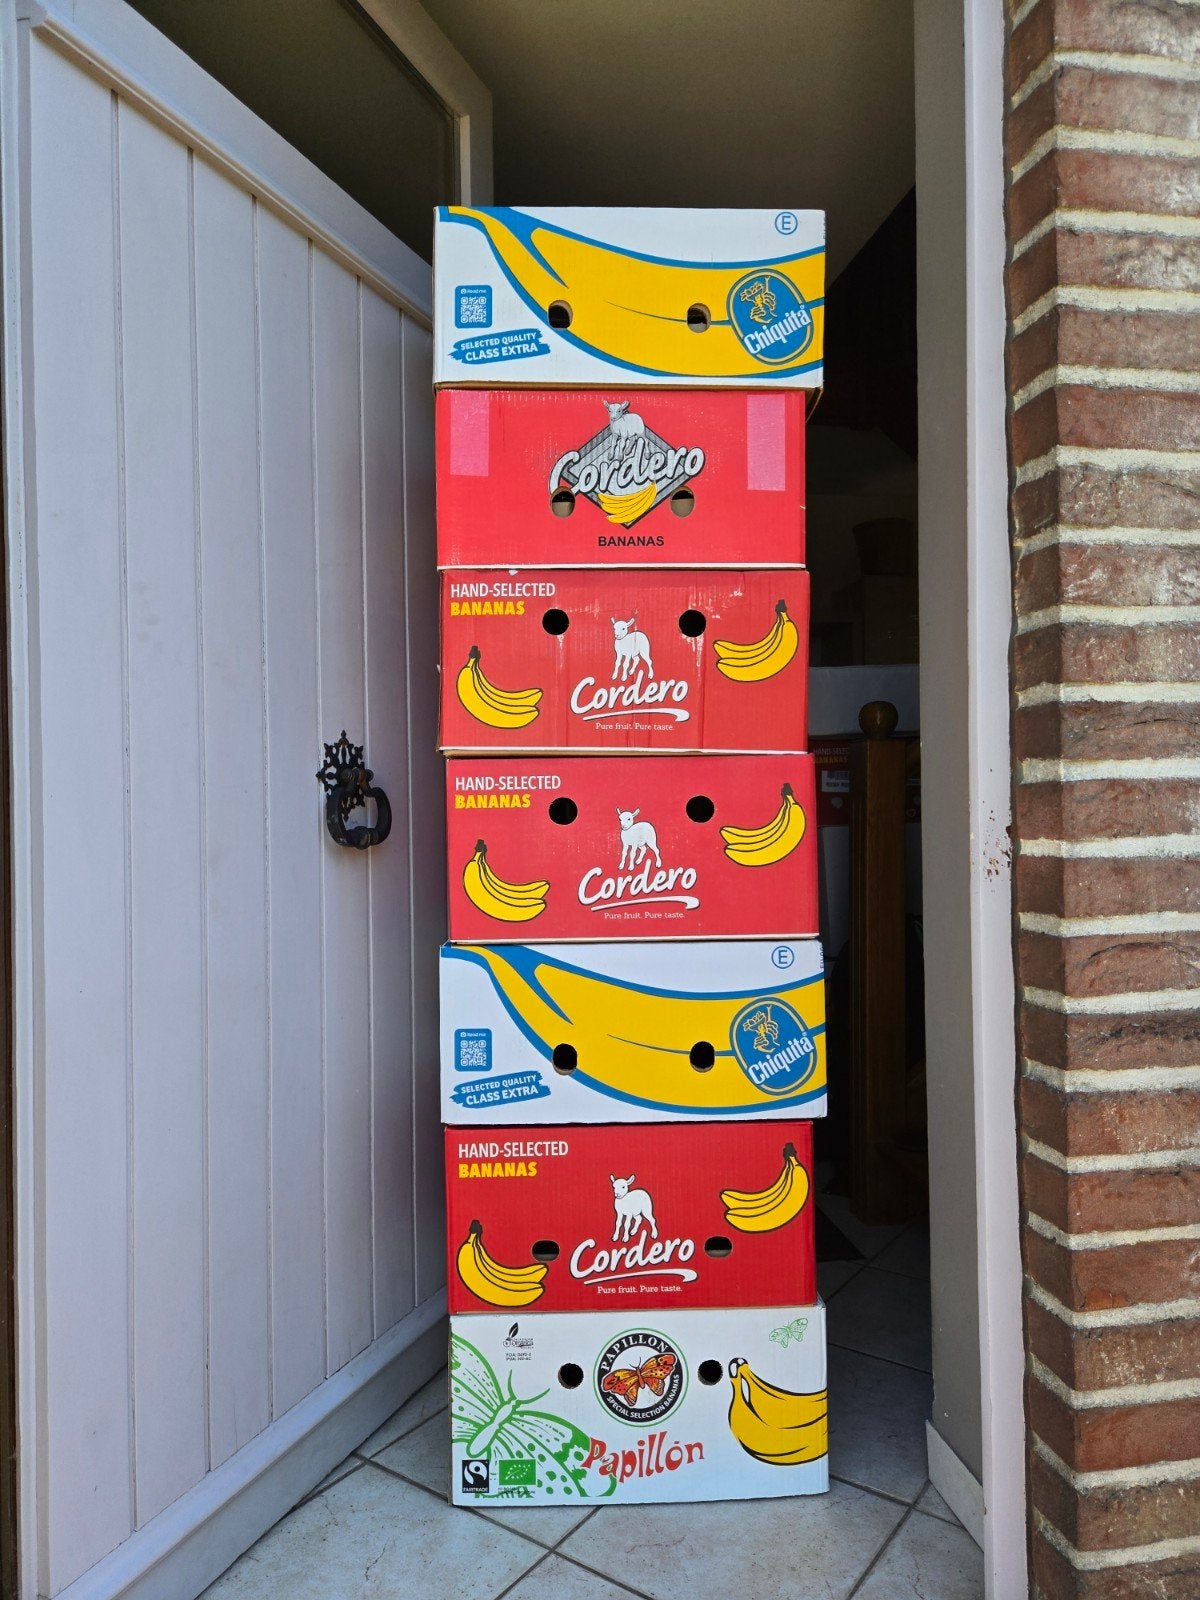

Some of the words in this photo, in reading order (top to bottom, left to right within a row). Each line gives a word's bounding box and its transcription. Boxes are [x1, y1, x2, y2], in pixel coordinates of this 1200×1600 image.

[743, 309, 811, 354] Chiquita
[460, 337, 500, 350] SELECTED
[502, 332, 537, 345] QUALITY
[465, 348, 500, 361] CLASS
[502, 343, 538, 356] EXTRA
[549, 437, 705, 494] Cordero
[598, 536, 664, 547] BANANAS
[450, 583, 556, 597] HAND-SELECTED
[450, 601, 525, 616] BANANAS
[570, 670, 688, 714] Cordero
[455, 776, 561, 790] HAND-SELECTED
[455, 794, 531, 809] BANANAS
[578, 859, 697, 905] Cordero
[644, 911, 662, 919] Pure
[748, 1036, 814, 1085] Chiquita
[461, 1082, 500, 1094] SELECTED
[502, 1075, 537, 1087] QUALITY
[466, 1091, 500, 1105] CLASS
[502, 1085, 539, 1099] EXTRA
[458, 1141, 569, 1158] HAND-SELECTED
[458, 1162, 538, 1178] BANANAS
[570, 1229, 695, 1278] Cordero
[597, 1286, 616, 1294] Pure
[640, 1285, 658, 1293] Pure
[601, 1334, 669, 1371] PAPILLON
[606, 1396, 629, 1416] SPECIAL
[630, 1406, 666, 1418] SELECTION
[663, 1374, 680, 1407] BANANAS
